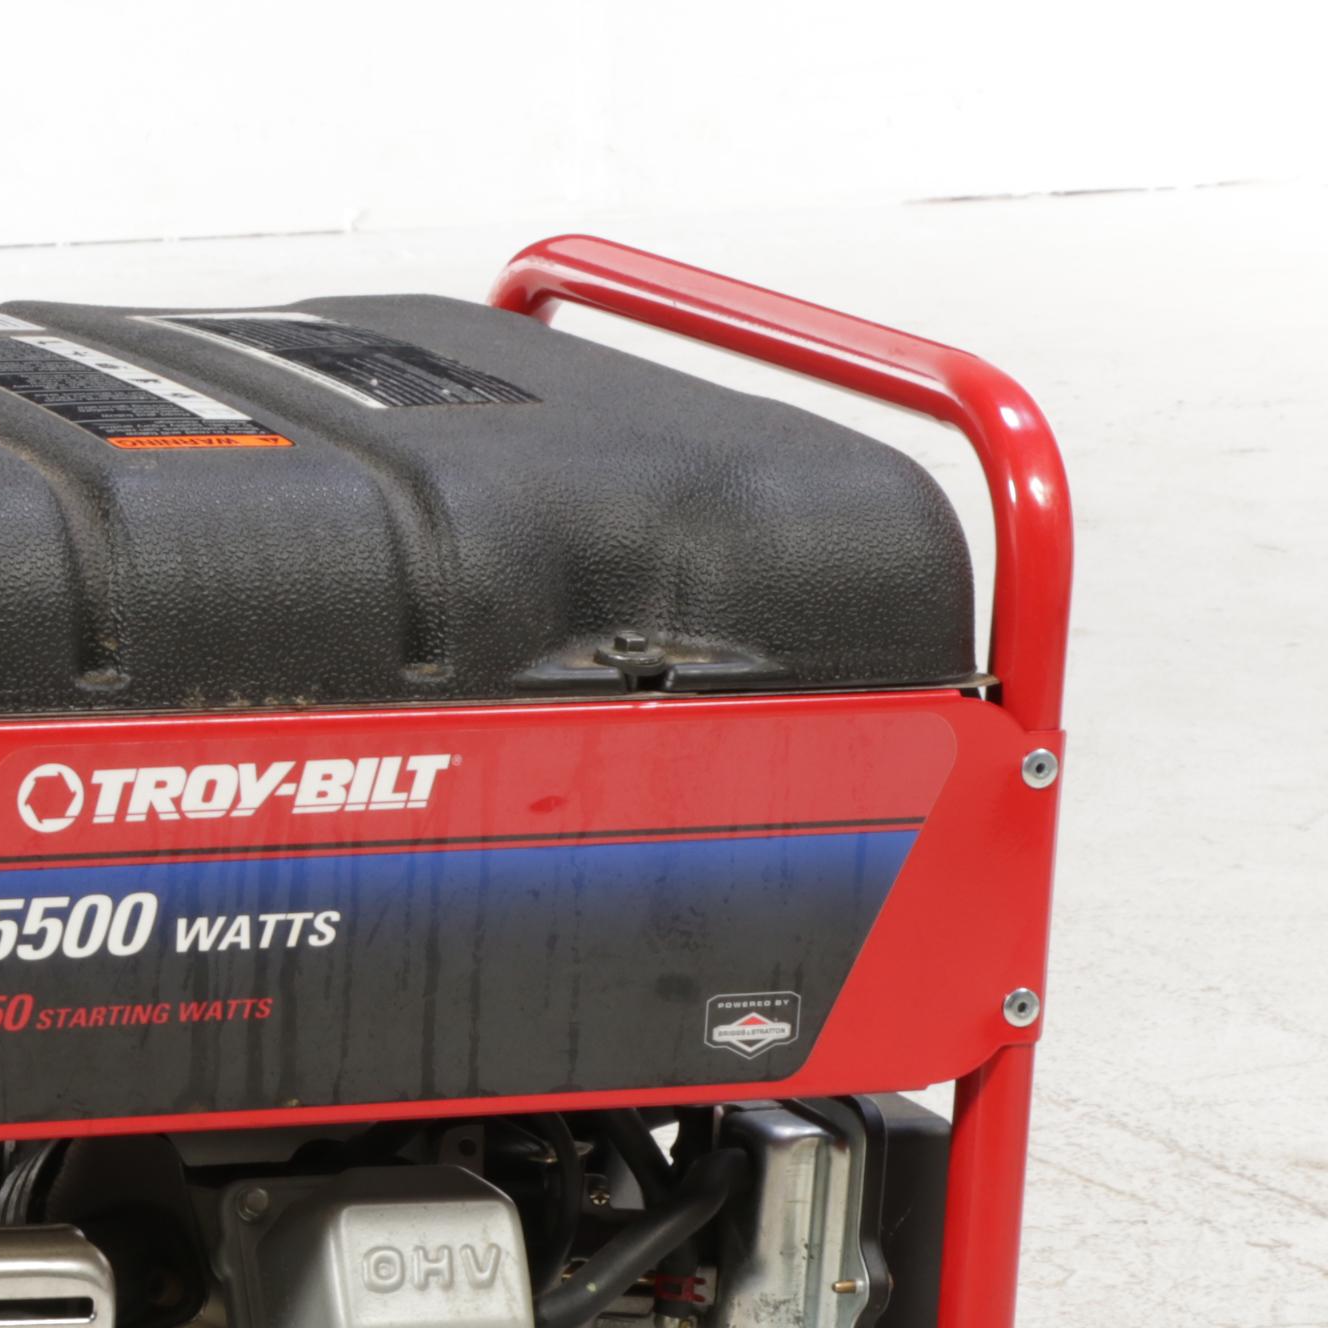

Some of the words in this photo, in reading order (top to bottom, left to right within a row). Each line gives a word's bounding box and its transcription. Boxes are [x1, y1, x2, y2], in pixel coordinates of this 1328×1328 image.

[117, 437, 240, 447] WARNING
[91, 754, 451, 823] TROY-BILT
[176, 911, 341, 953] WATTS
[36, 1002, 172, 1030] STARTING
[178, 998, 273, 1023] WATTS
[717, 1000, 771, 1009] POWERED
[775, 999, 790, 1007] BY
[362, 1243, 502, 1293] OHV
